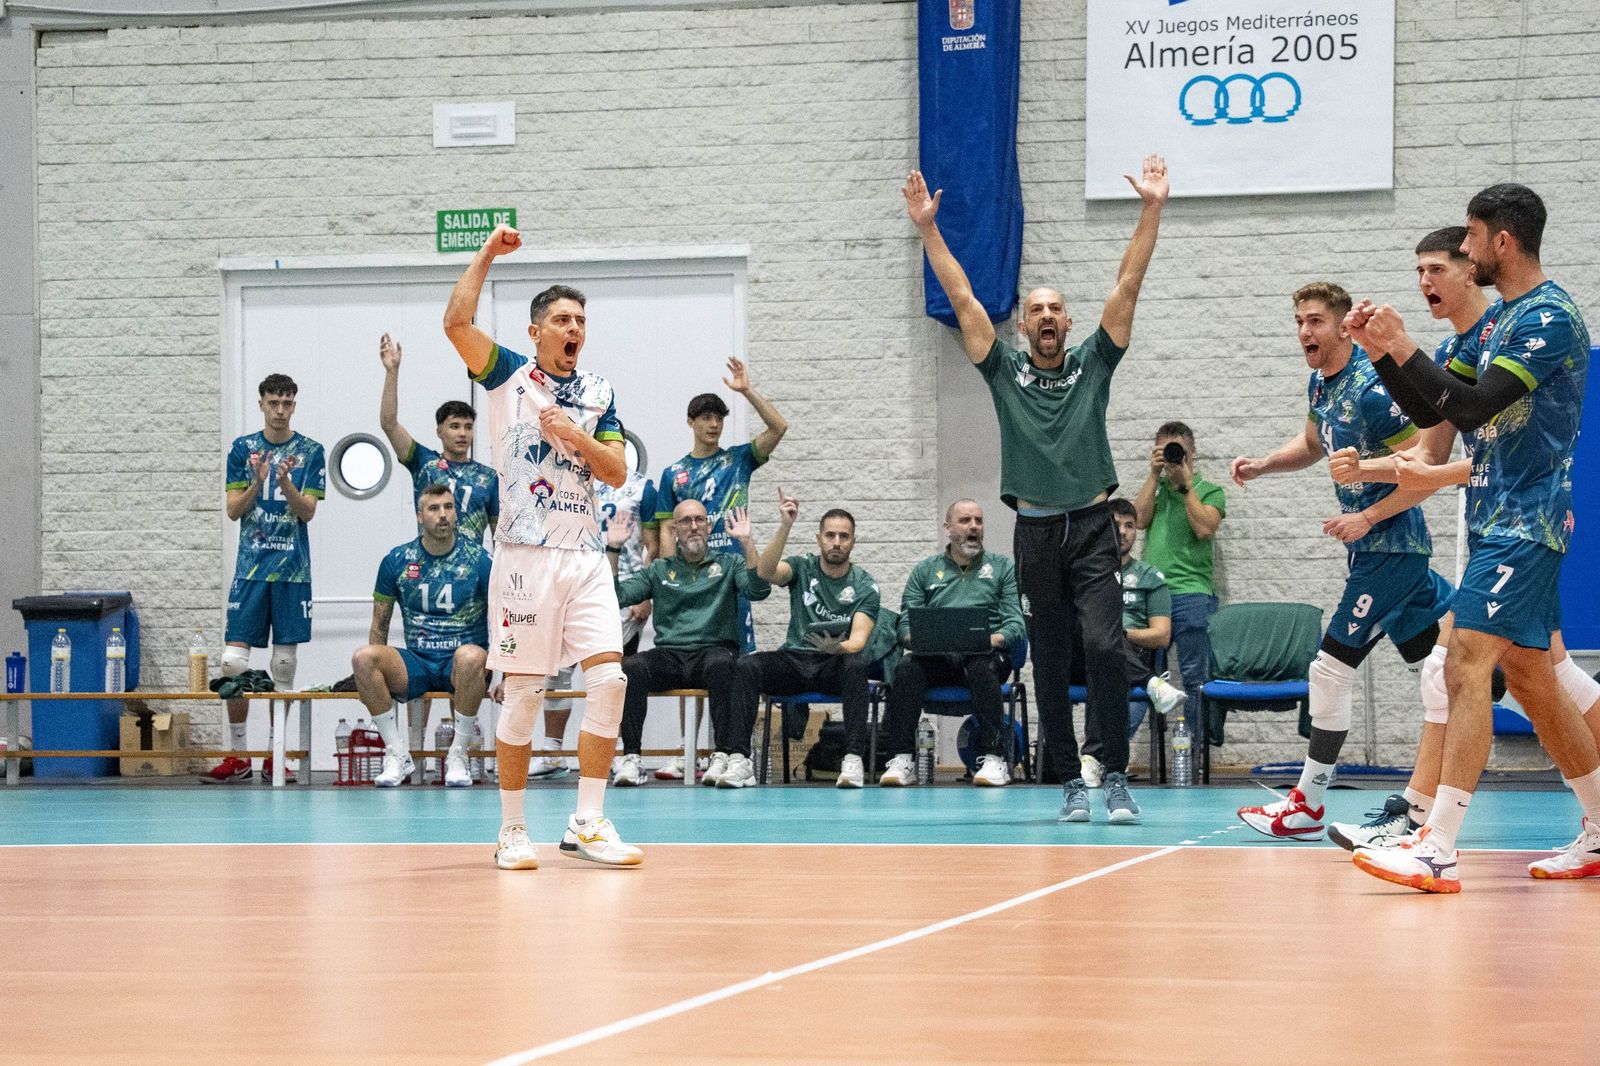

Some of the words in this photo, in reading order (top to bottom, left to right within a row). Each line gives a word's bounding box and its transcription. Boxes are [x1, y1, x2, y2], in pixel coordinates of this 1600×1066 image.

[1125, 20, 1150, 35] XV
[1156, 18, 1219, 36] Juegos
[1226, 11, 1359, 31] Mediterráneos
[942, 33, 986, 45] DIPUTACIÓN
[942, 44, 954, 52] DE
[1124, 36, 1254, 70] Almería
[1271, 33, 1358, 63] 2005
[443, 213, 490, 230] SALIDA
[493, 211, 511, 227] DE
[440, 231, 491, 248] EMERGE
[559, 490, 583, 502] COST
[1489, 564, 1514, 594] 7
[417, 583, 456, 614] 14
[1352, 593, 1374, 619] 9
